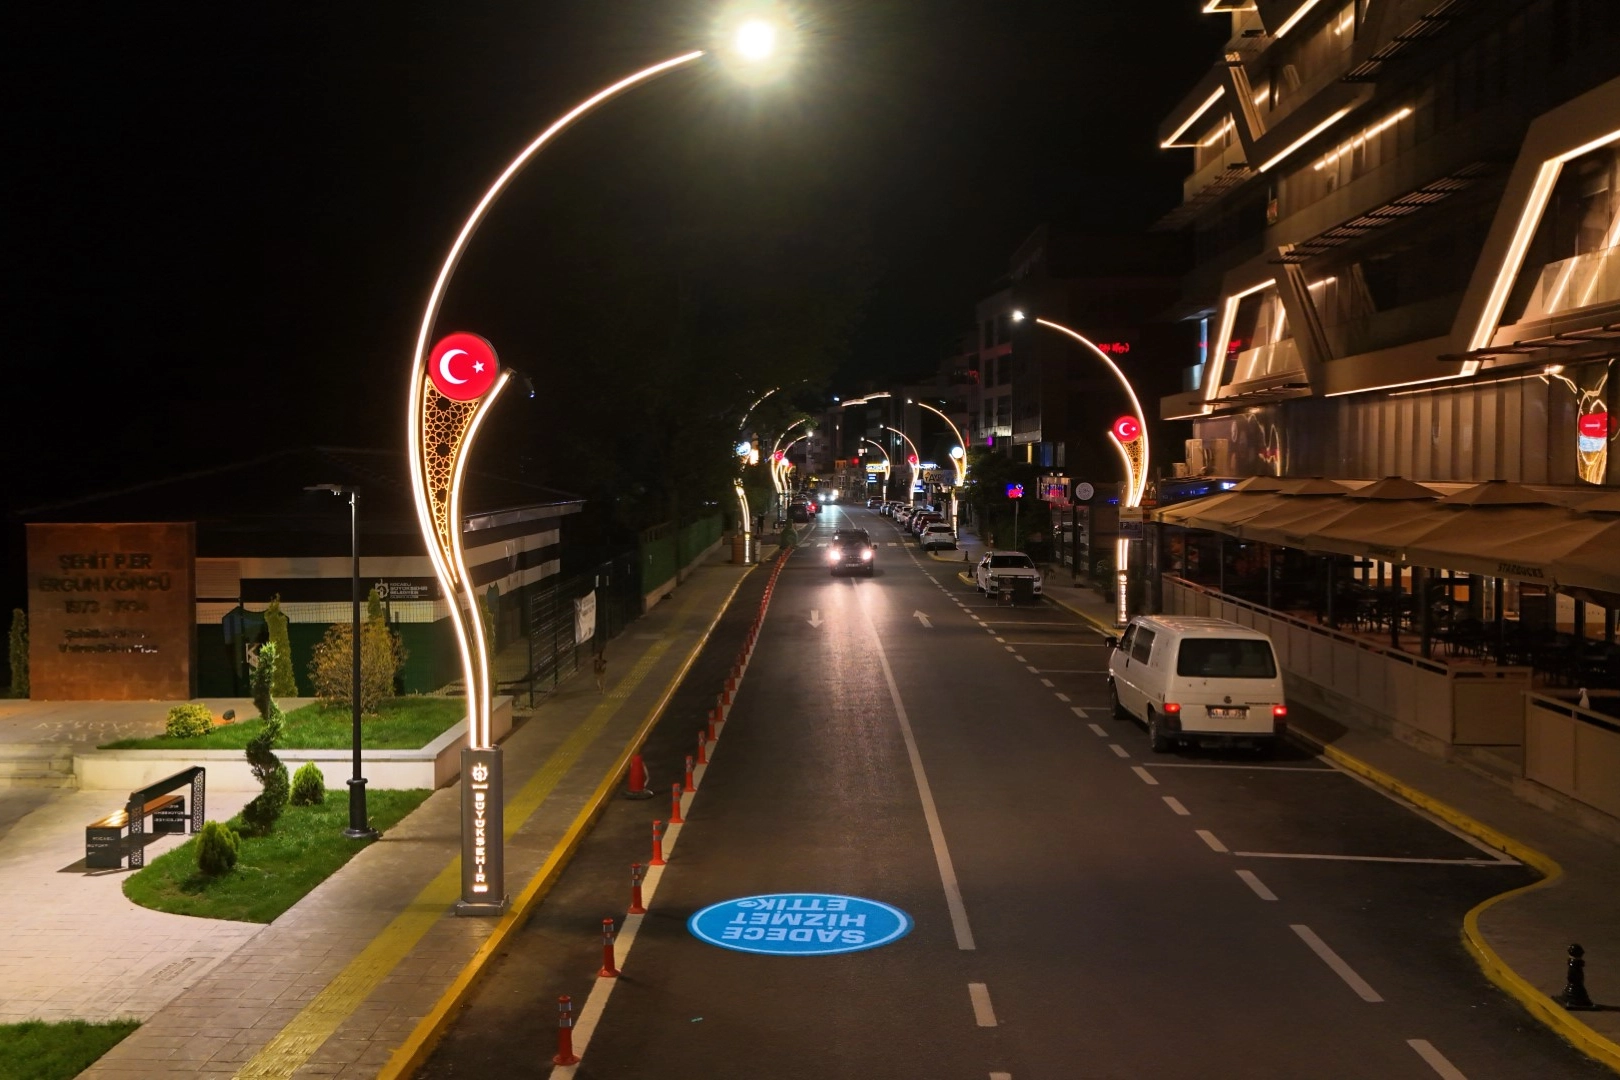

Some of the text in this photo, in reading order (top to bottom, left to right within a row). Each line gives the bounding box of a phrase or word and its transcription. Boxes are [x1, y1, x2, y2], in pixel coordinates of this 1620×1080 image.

[755, 899, 848, 913] ETTİK
[729, 912, 866, 929] HİZMET
[722, 926, 866, 944] SADECE
